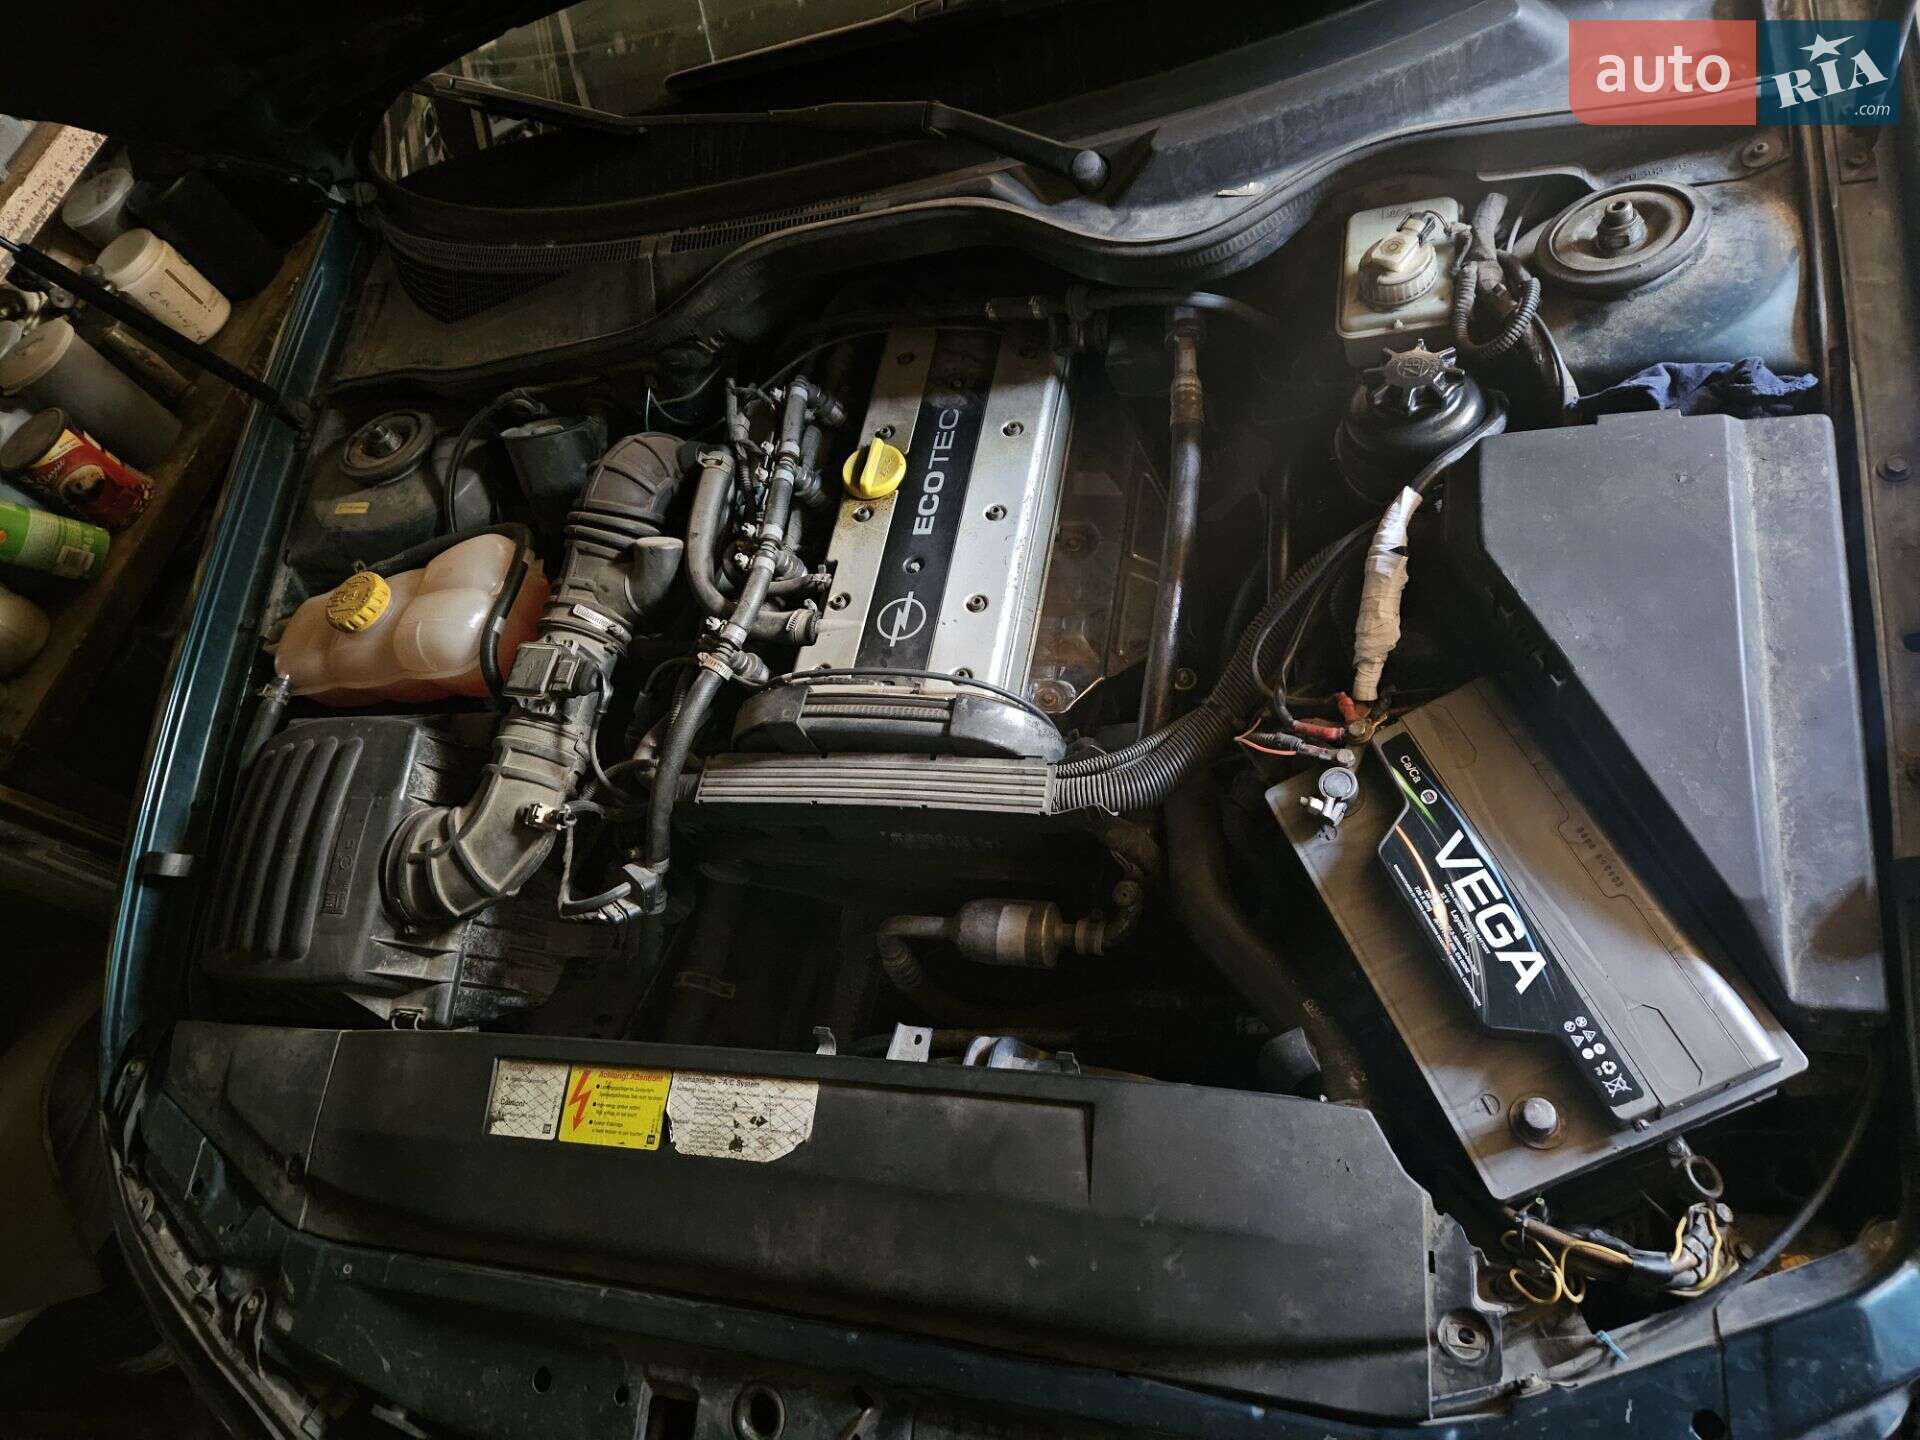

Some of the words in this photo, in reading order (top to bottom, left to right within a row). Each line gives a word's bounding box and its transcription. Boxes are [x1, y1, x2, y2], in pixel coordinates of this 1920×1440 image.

[912, 408, 961, 536] ECOTEC
[1400, 754, 1422, 784] Ca/Ca
[1434, 828, 1547, 995] VEGA
